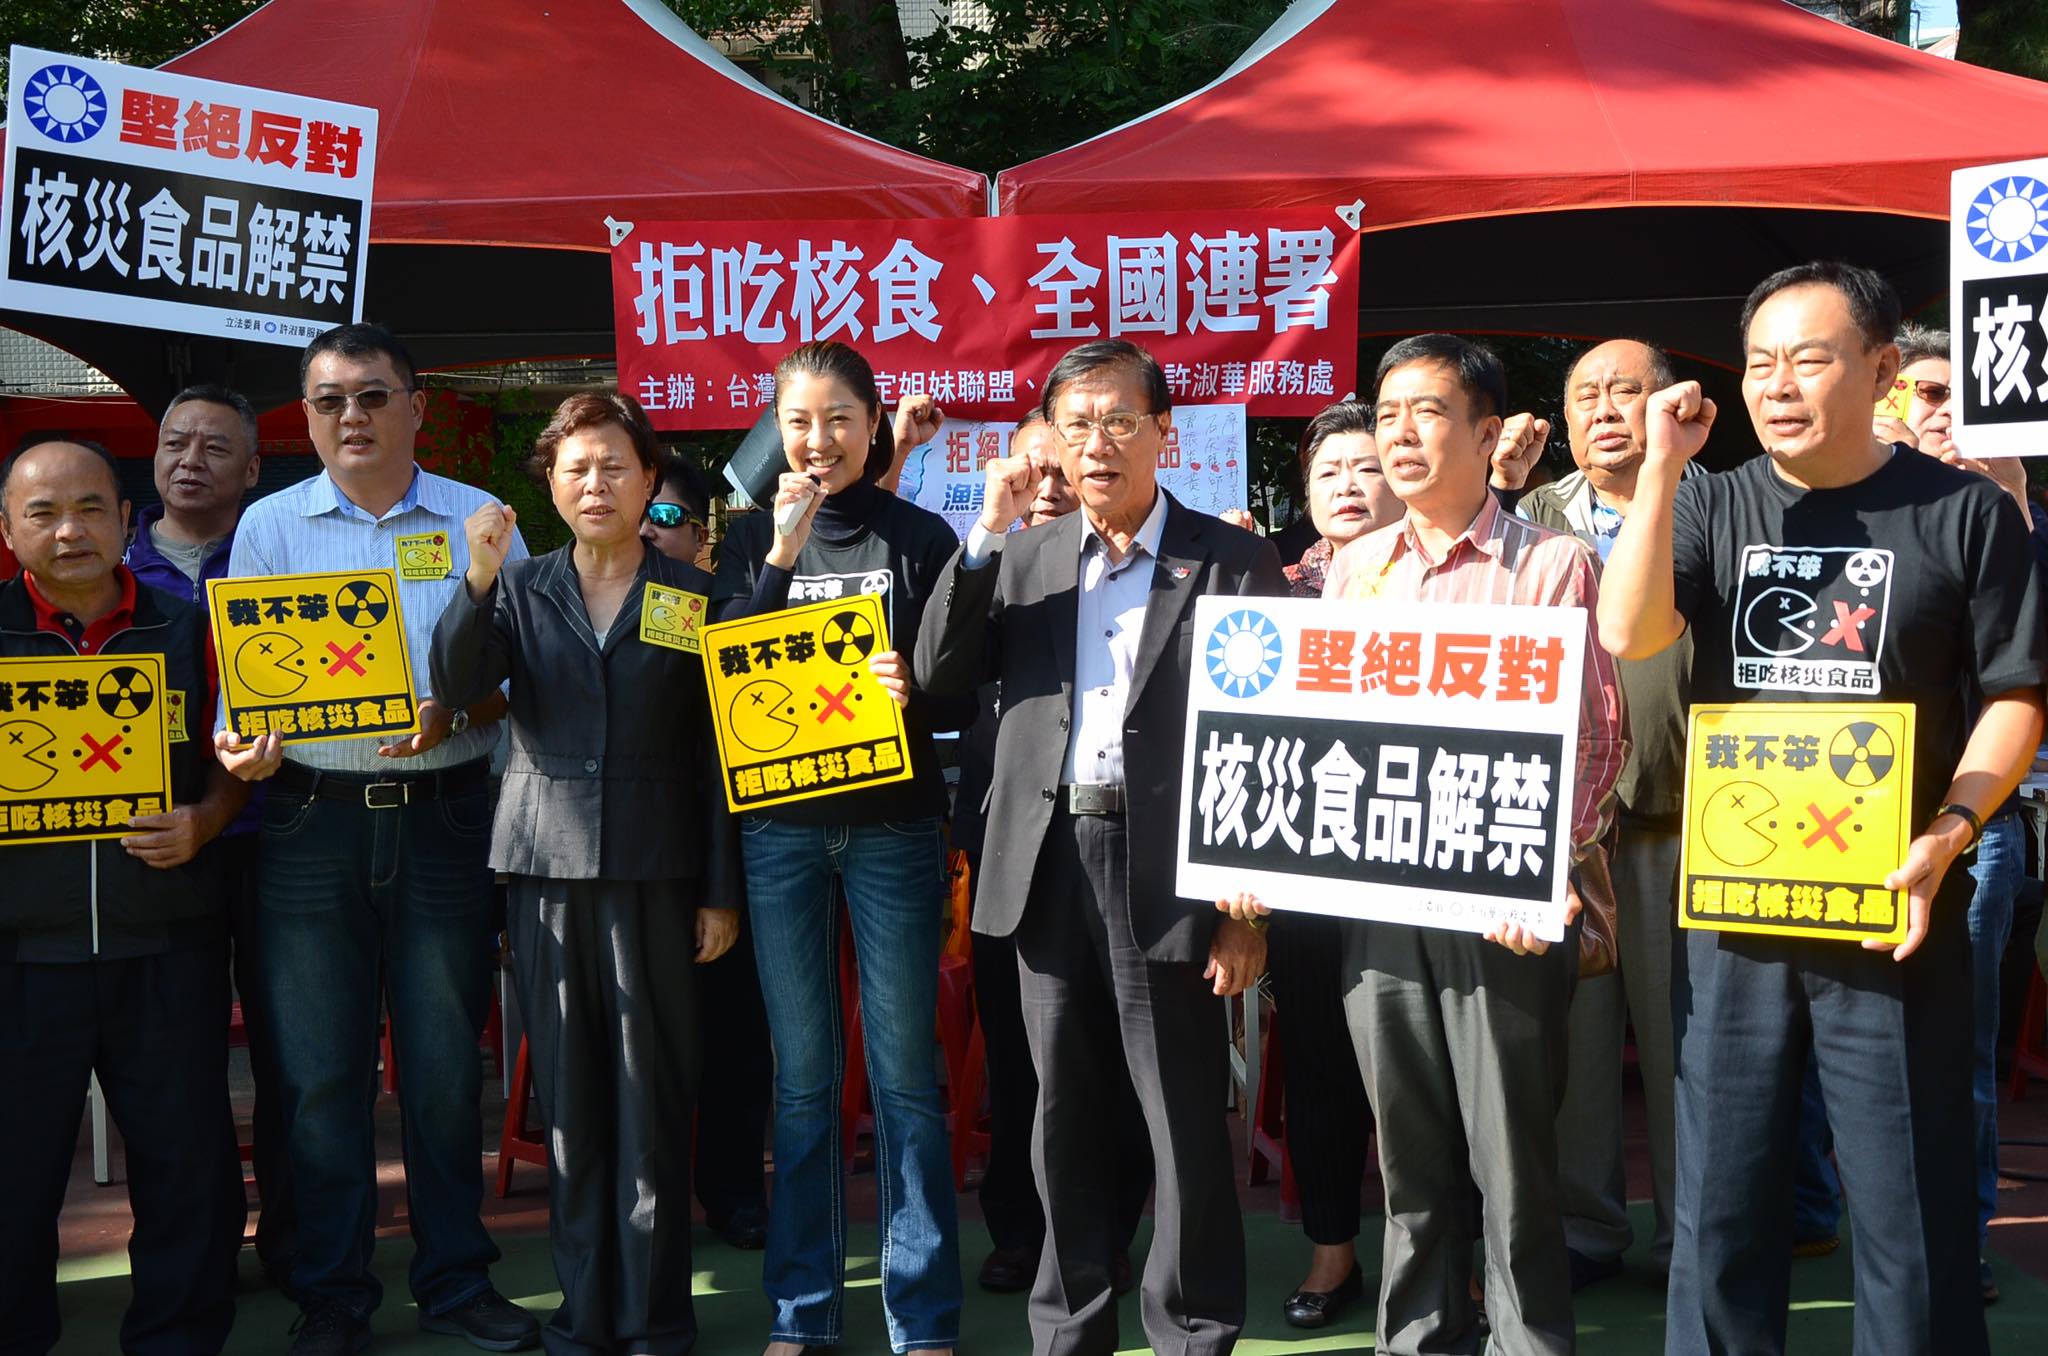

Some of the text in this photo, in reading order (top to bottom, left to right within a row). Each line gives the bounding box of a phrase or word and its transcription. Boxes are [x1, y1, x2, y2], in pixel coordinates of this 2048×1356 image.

[119, 88, 363, 179] 堅絕反對
[20, 167, 352, 304] 核災食品解禁
[631, 226, 1339, 345] 拒吃核食、全國連署
[225, 317, 261, 331] 立法委員
[1972, 294, 2048, 407] 核
[1164, 359, 1335, 397] 許淑華服務處
[227, 594, 330, 627] 我不笨
[718, 631, 816, 678] 我不笨
[1295, 628, 1565, 704] 堅絕反對
[1738, 662, 1874, 689] 拒吃核災食品
[238, 699, 411, 738] 拒吃核災食品
[734, 740, 902, 798] 拒吃核災食品
[1705, 733, 1820, 771] 我不笨
[1198, 731, 1551, 876] 核災食品解禁
[1692, 880, 1894, 925] 拒吃核災食品
